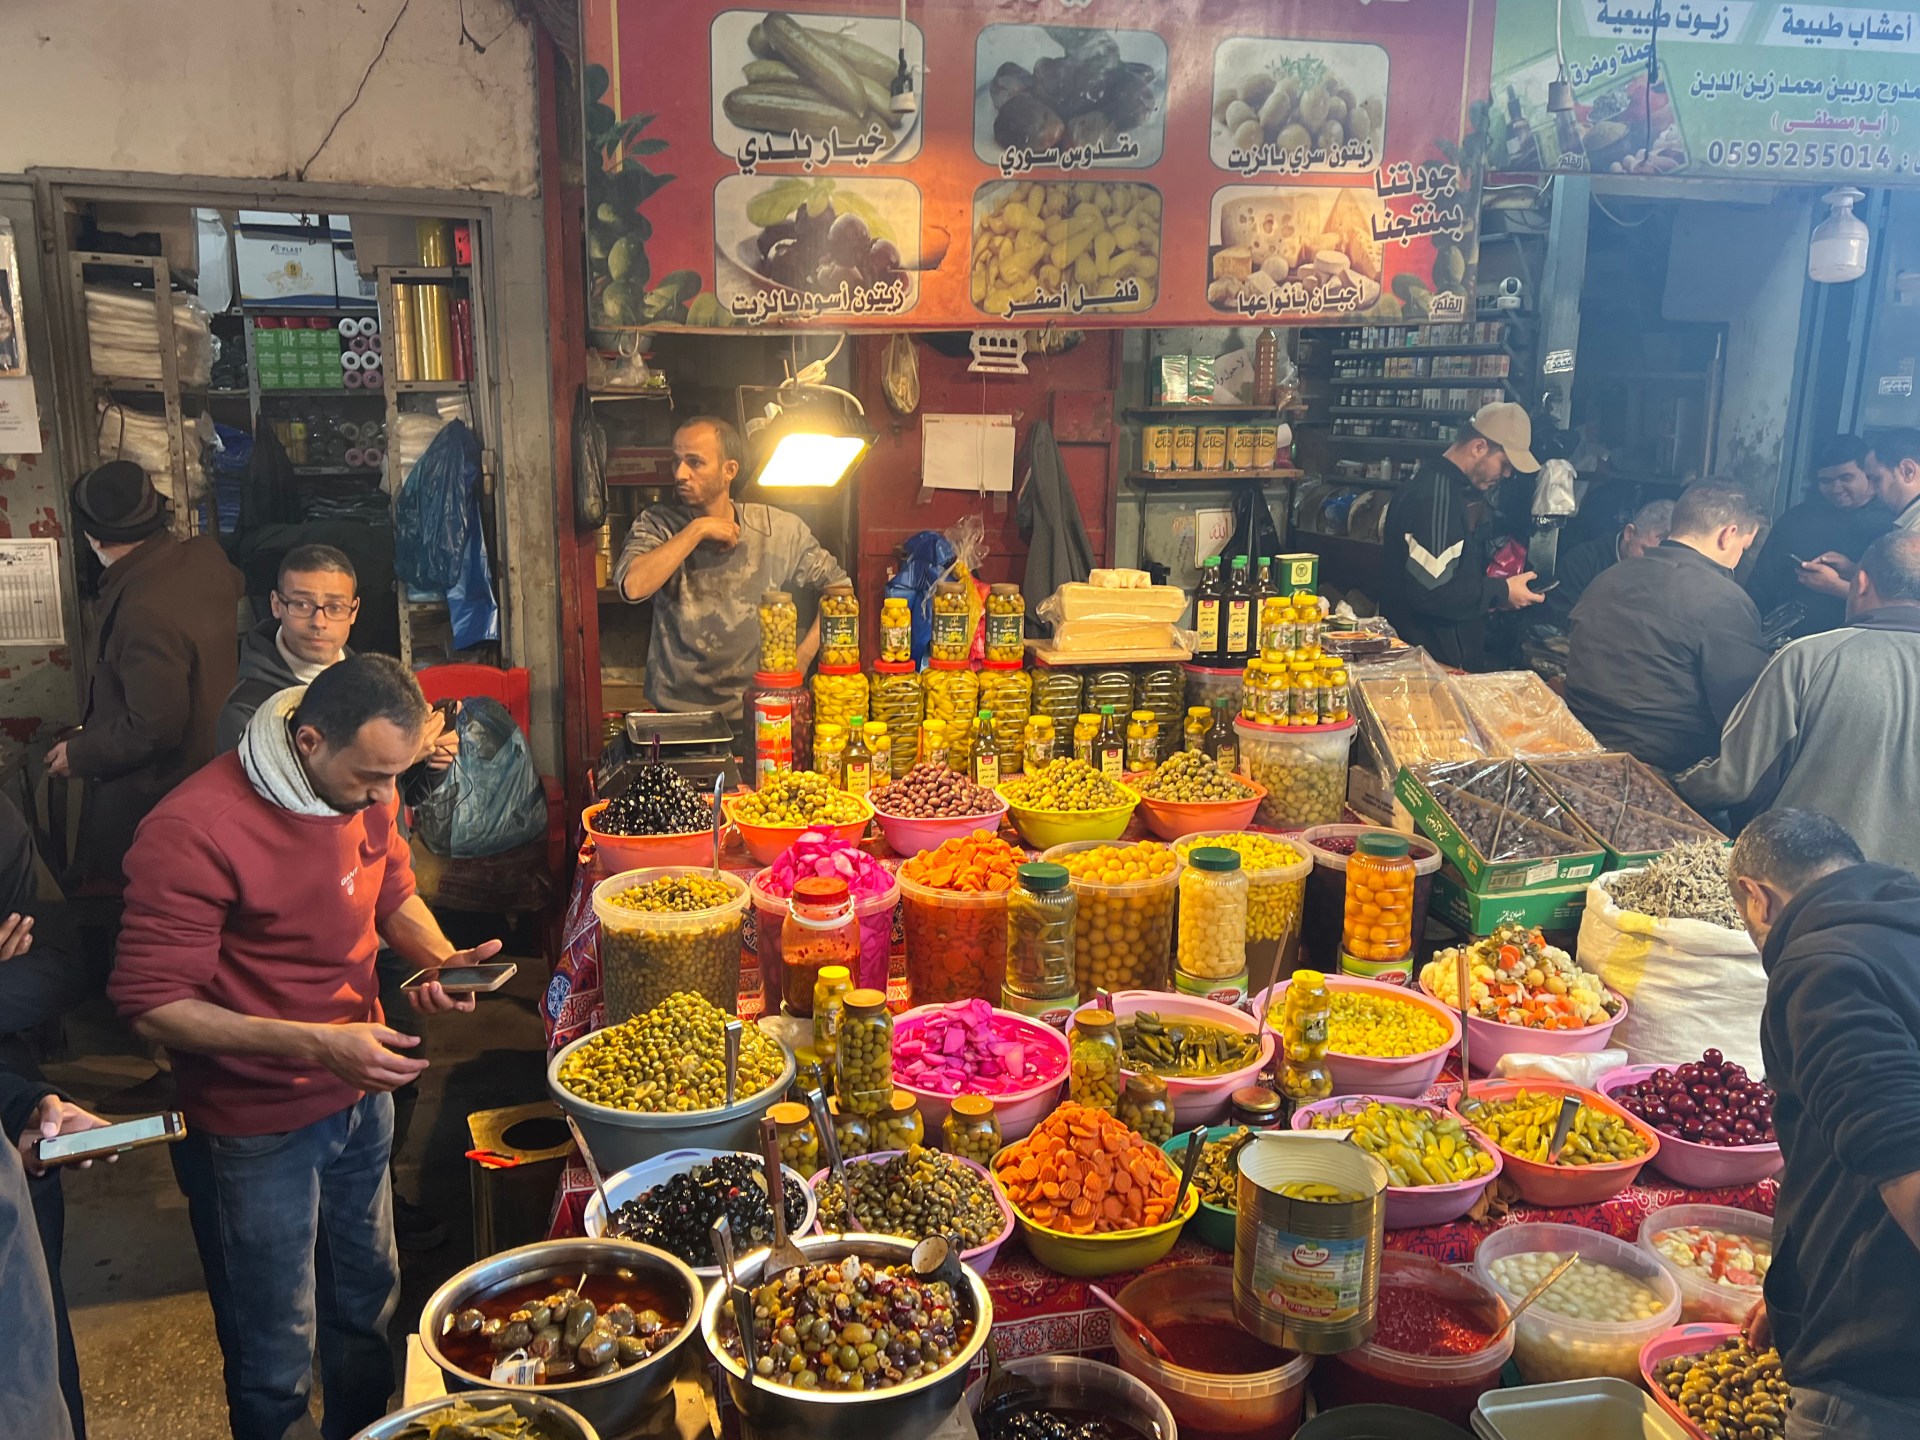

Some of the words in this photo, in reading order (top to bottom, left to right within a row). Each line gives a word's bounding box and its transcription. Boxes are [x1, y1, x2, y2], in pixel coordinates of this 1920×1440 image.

[1597, 0, 1671, 34] طبيعية
[1675, 4, 1729, 39] زيوت
[1782, 7, 1843, 44] طبيعة
[1848, 13, 1911, 46] أعشاب
[1570, 56, 1617, 87] ومفرق
[1690, 71, 1741, 98] الدين
[1743, 72, 1774, 99] زين
[1779, 76, 1823, 94] محمد
[1877, 80, 1920, 103] مدوح
[737, 128, 814, 175] بلدي
[816, 124, 886, 165] خيار
[1061, 134, 1139, 169] مقدوس
[1228, 144, 1287, 176] بالزيت
[1289, 148, 1326, 174] سري
[1328, 139, 1374, 168] زيتون
[1707, 140, 1891, 169] 0595255014
[1000, 146, 1059, 177] سوري
[1375, 161, 1458, 200] جودتنا
[1371, 203, 1464, 247] بمنتجنا
[801, 281, 849, 316] أسود
[852, 281, 906, 314] زيتون
[1001, 283, 1068, 319] أصفر
[1072, 279, 1139, 312] فلفل
[1237, 283, 1309, 318] بأنواعها
[1310, 279, 1364, 312] أجبان
[1209, 517, 1228, 540] الله
[341, 866, 358, 887] GANT
